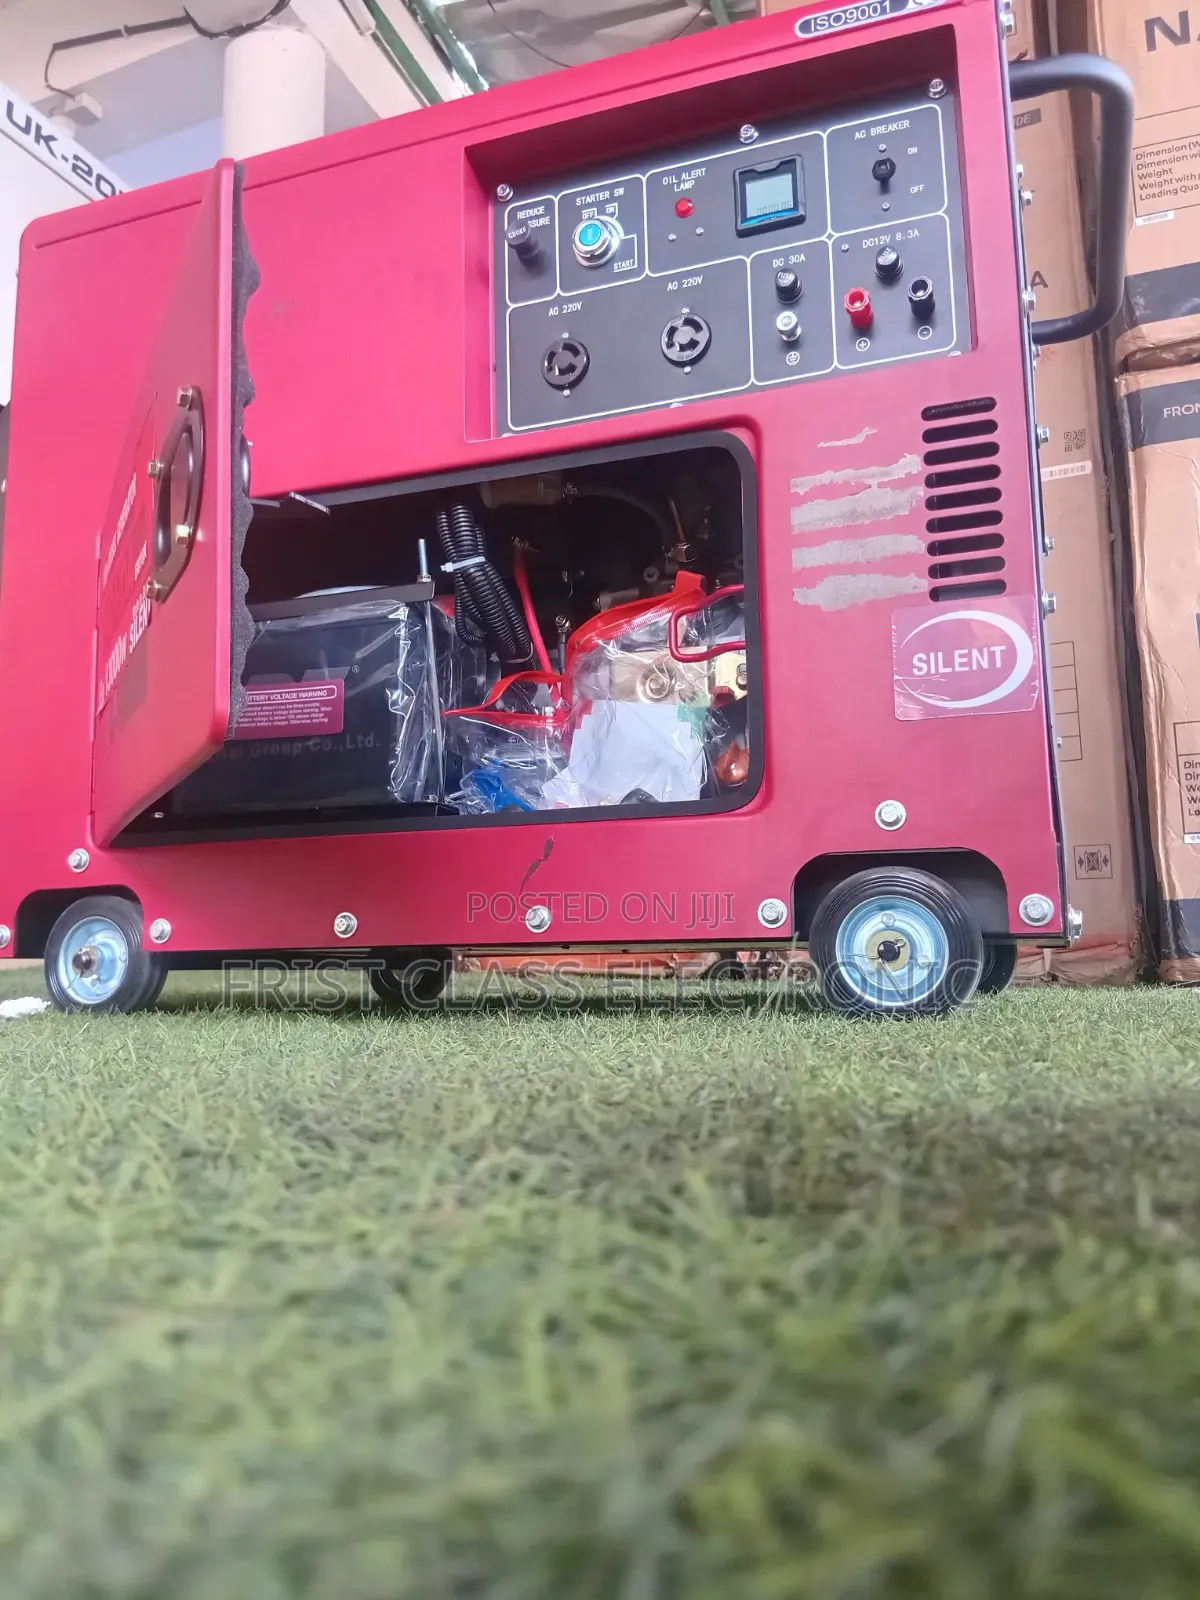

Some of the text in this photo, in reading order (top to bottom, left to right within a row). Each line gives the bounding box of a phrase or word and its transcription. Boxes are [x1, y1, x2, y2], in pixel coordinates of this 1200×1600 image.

[810, 0, 890, 32] ISO9001
[1144, 10, 1200, 52] N
[854, 120, 911, 140] AC BREAKER
[6, 99, 123, 198] UK-20
[907, 146, 918, 155] ON
[1135, 144, 1187, 161] Dimension
[1136, 154, 1188, 171] Dimension
[662, 167, 707, 186] OIL ALERT
[1138, 168, 1173, 180] Weight
[1139, 178, 1174, 191] Weight
[1175, 172, 1196, 184] with
[674, 180, 695, 192] LAMP
[910, 184, 925, 194] OFF
[575, 187, 625, 206] STARTER SW
[1139, 188, 1178, 201] Loading
[517, 206, 546, 220] REDUCE
[582, 212, 595, 220] OFF
[605, 206, 615, 214] ON
[862, 228, 920, 249] DC12V 8.3A
[613, 259, 634, 270] START
[772, 253, 806, 268] DC 30A
[667, 275, 704, 291] AC 220V
[548, 302, 583, 317] AC 220V
[912, 646, 1007, 676] SILENT
[270, 692, 298, 700] VOLTAGE
[298, 690, 328, 698] WARNING
[1185, 771, 1200, 781] Di
